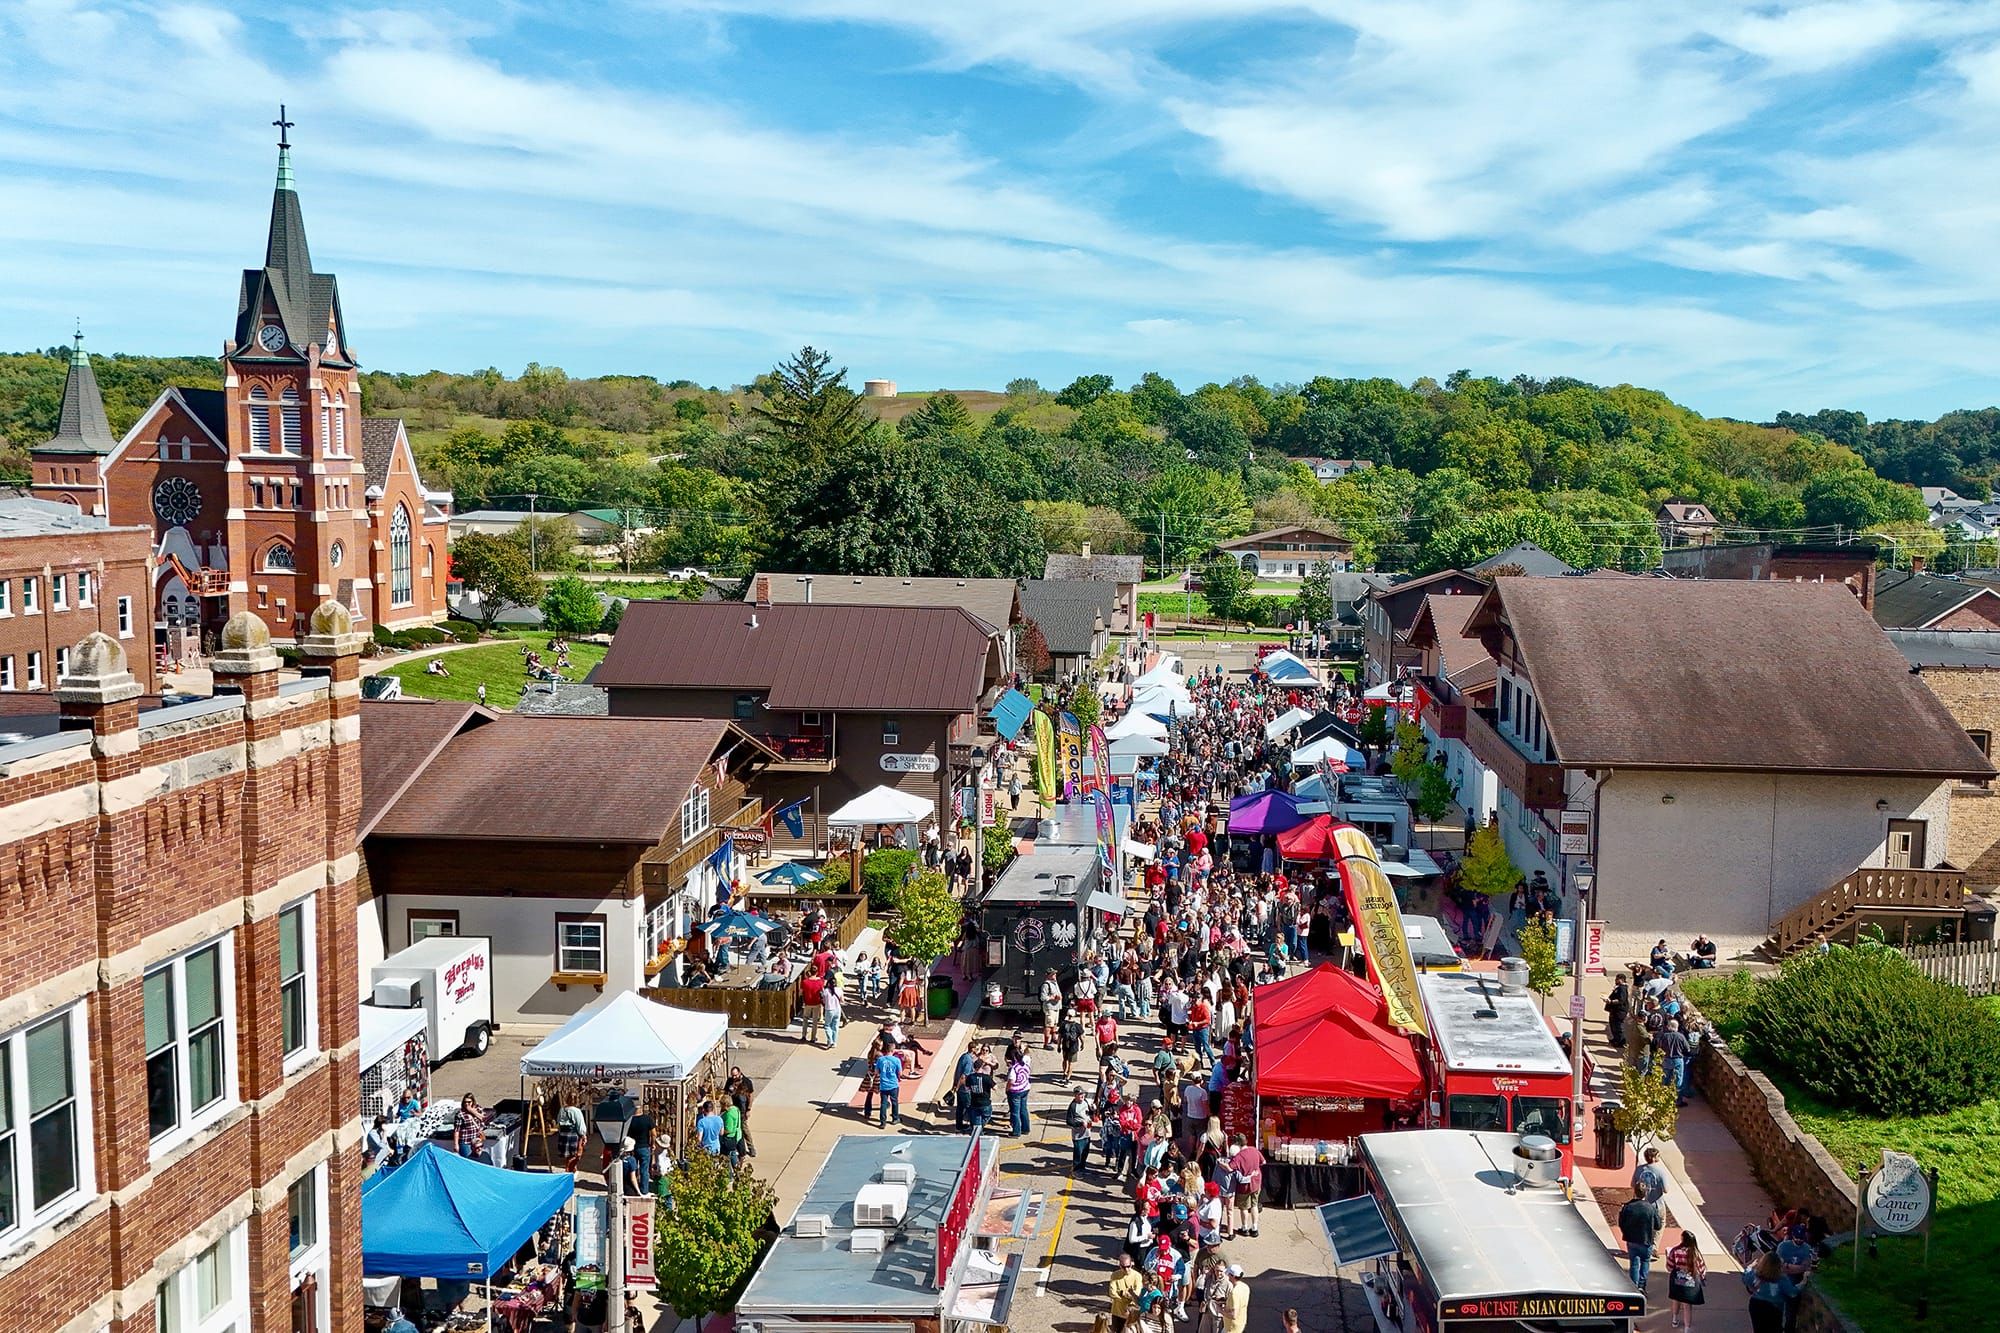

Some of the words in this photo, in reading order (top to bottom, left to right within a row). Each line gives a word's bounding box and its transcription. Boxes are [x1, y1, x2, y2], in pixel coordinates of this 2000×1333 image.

[1346, 712, 1360, 720] STOP
[903, 761, 931, 770] SHOPPE
[985, 793, 993, 817] PROST
[724, 831, 764, 841] KEEMAN'S
[1589, 927, 1601, 965] POLKA
[594, 1064, 635, 1078] Home
[1876, 1196, 1921, 1210] Canter
[1887, 1209, 1909, 1221] Inn
[632, 1212, 649, 1268] YODEL
[1479, 1301, 1493, 1316] KC
[1494, 1300, 1519, 1315] TASTE
[1521, 1299, 1557, 1315] ASIAN
[1558, 1298, 1606, 1315] CUISINE
